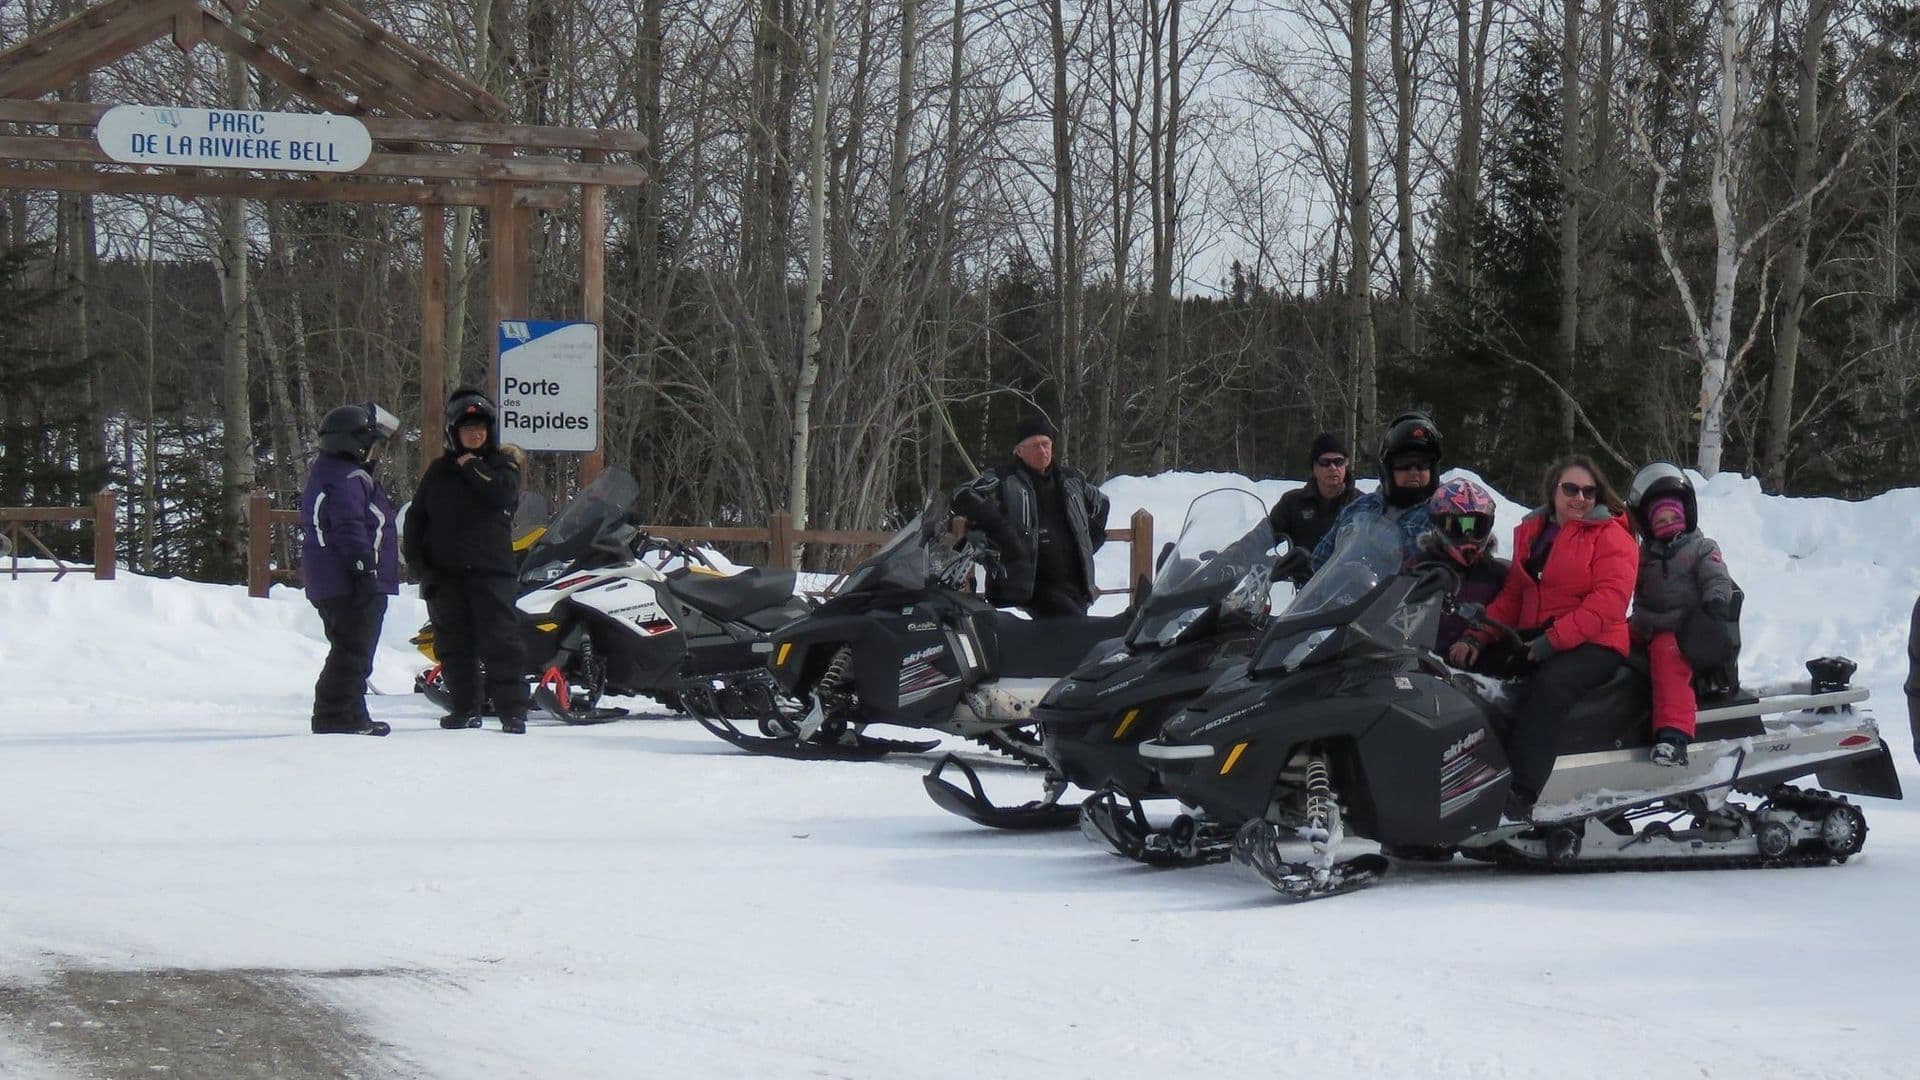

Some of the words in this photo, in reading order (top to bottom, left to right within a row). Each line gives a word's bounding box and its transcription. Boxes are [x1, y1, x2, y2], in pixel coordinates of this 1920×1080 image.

[208, 112, 265, 134] PARC
[131, 133, 158, 154] DE
[166, 135, 192, 156] LA
[199, 135, 282, 159] RIVIÈRE
[289, 141, 339, 163] BELL
[504, 377, 560, 396] Porte
[503, 398, 521, 407] des
[504, 411, 589, 433] Rapides
[1205, 715, 1231, 731] 600
